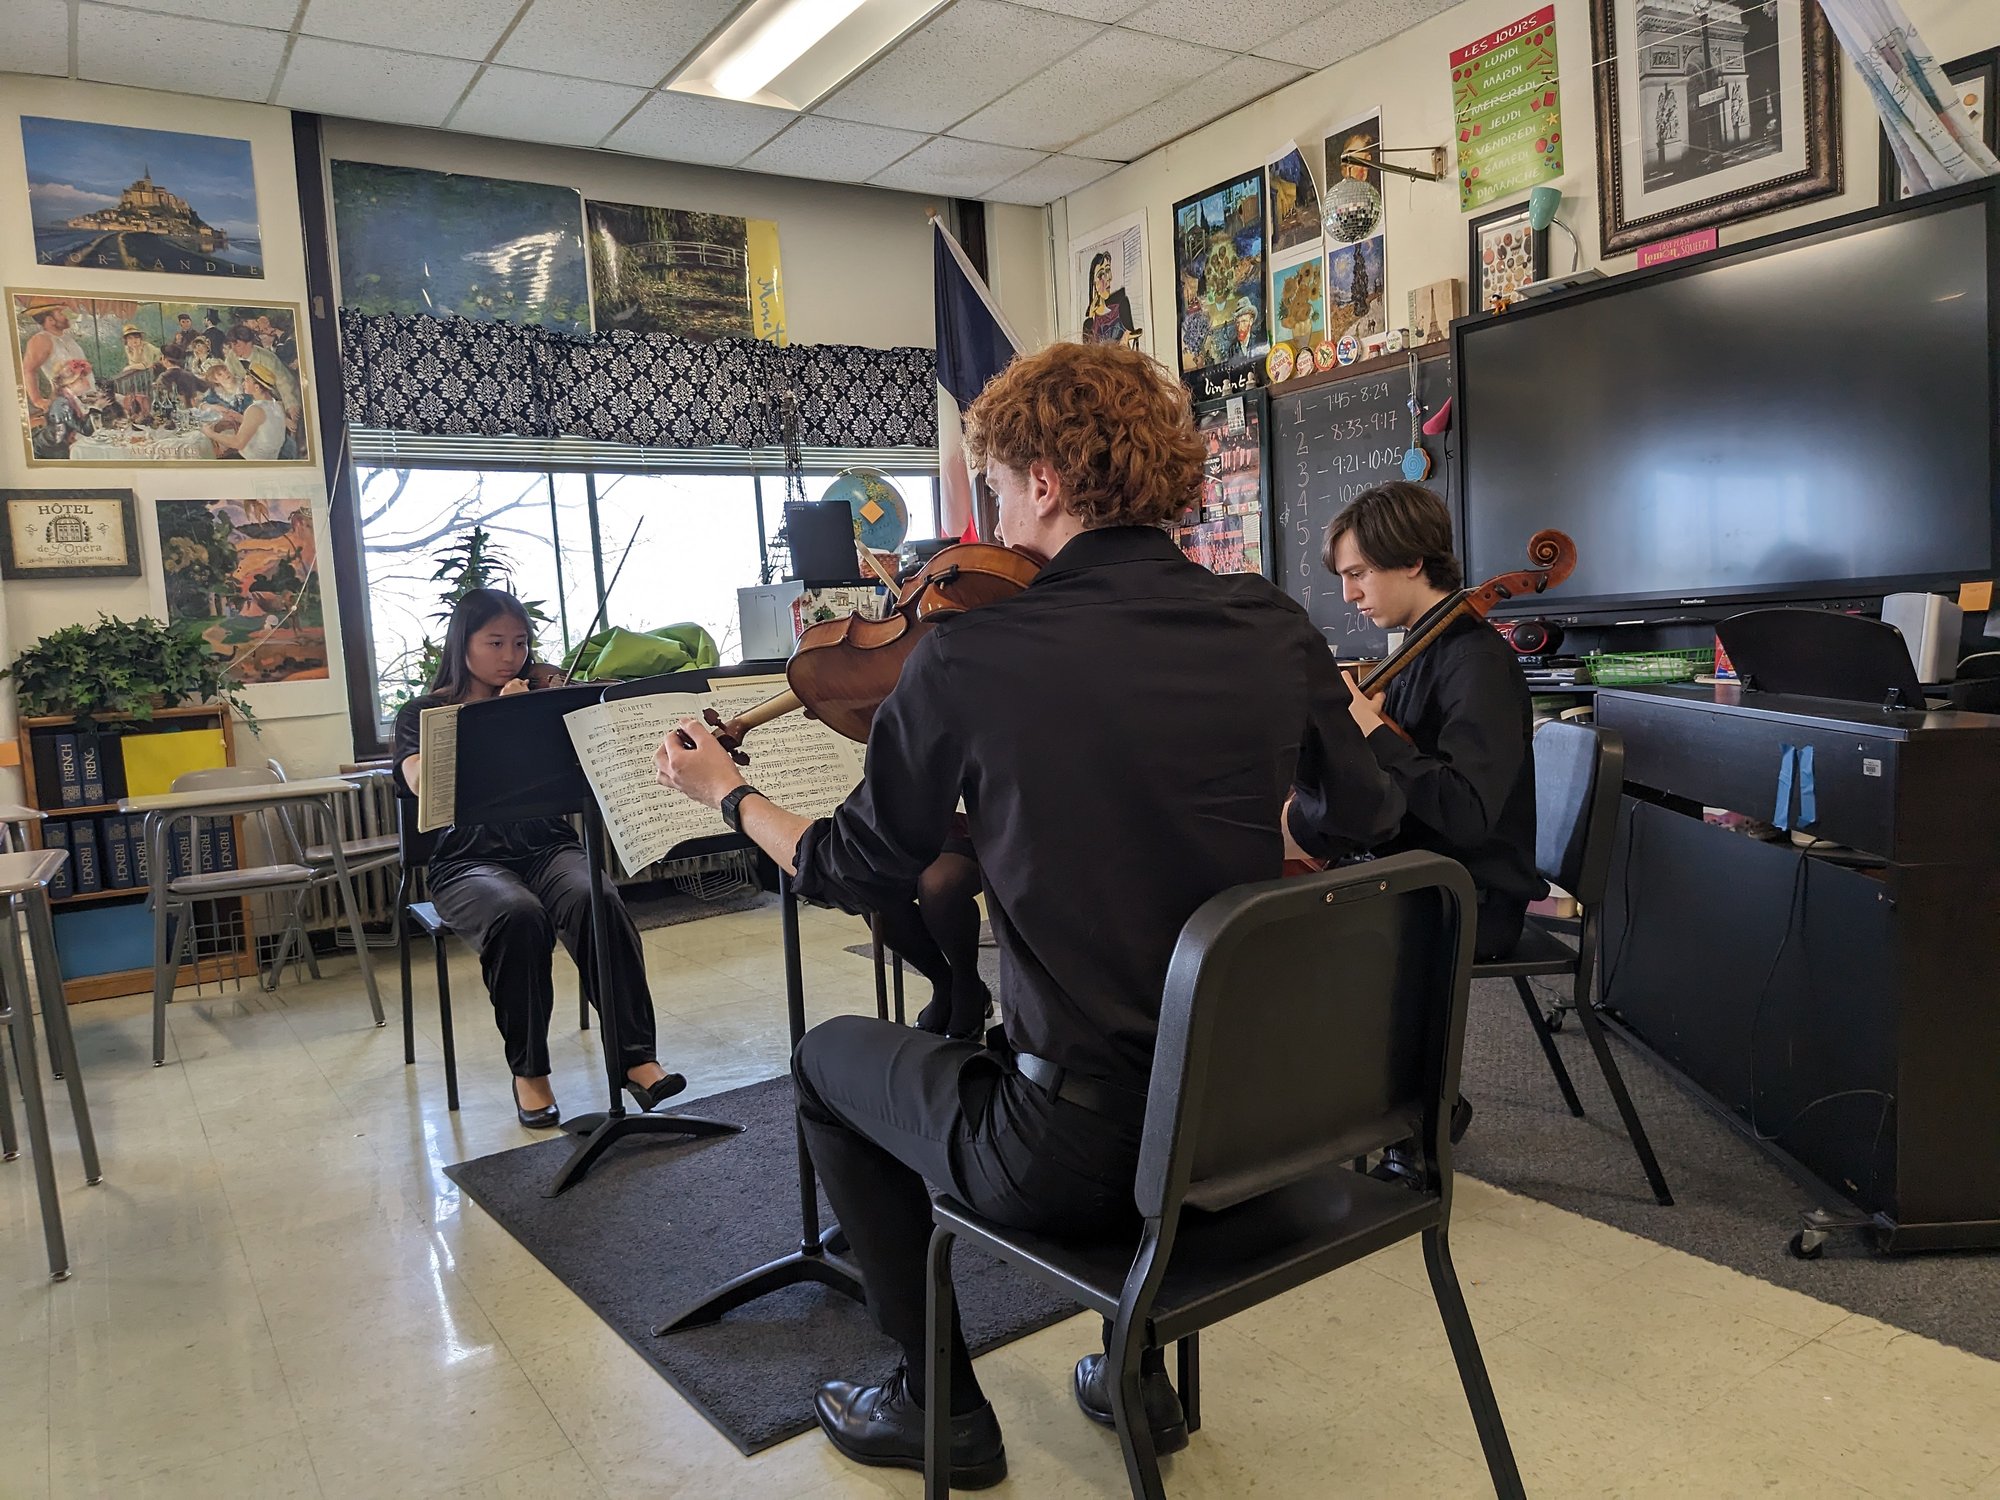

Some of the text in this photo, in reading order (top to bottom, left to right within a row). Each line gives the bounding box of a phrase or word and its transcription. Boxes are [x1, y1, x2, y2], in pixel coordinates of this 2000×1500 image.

[1464, 16, 1537, 58] LES JOURS
[1485, 45, 1519, 68] LUNDI
[1483, 64, 1522, 88] MARDI
[1471, 80, 1537, 115] MERCREDI
[1488, 110, 1521, 130] JEUDI
[1475, 124, 1536, 155] VENDREDI
[1484, 151, 1529, 175] SAMEDI
[1477, 168, 1540, 199] DIMANCHE
[757, 275, 785, 348] Monet
[1296, 432, 1309, 455] 2
[1297, 461, 1310, 488] 3
[38, 502, 94, 515] HÔTEL
[1297, 490, 1308, 516] 4
[1296, 519, 1311, 546] 5
[37, 544, 50, 553] de
[1300, 550, 1311, 577] 6
[60, 743, 76, 782] FRENCH
[84, 747, 98, 780] FRENC
[114, 843, 129, 881] FRENCH
[179, 836, 192, 873] FRENCH
[200, 833, 213, 871] FRENCH
[219, 831, 232, 868] FRENCH
[80, 847, 95, 885] FRENCH
